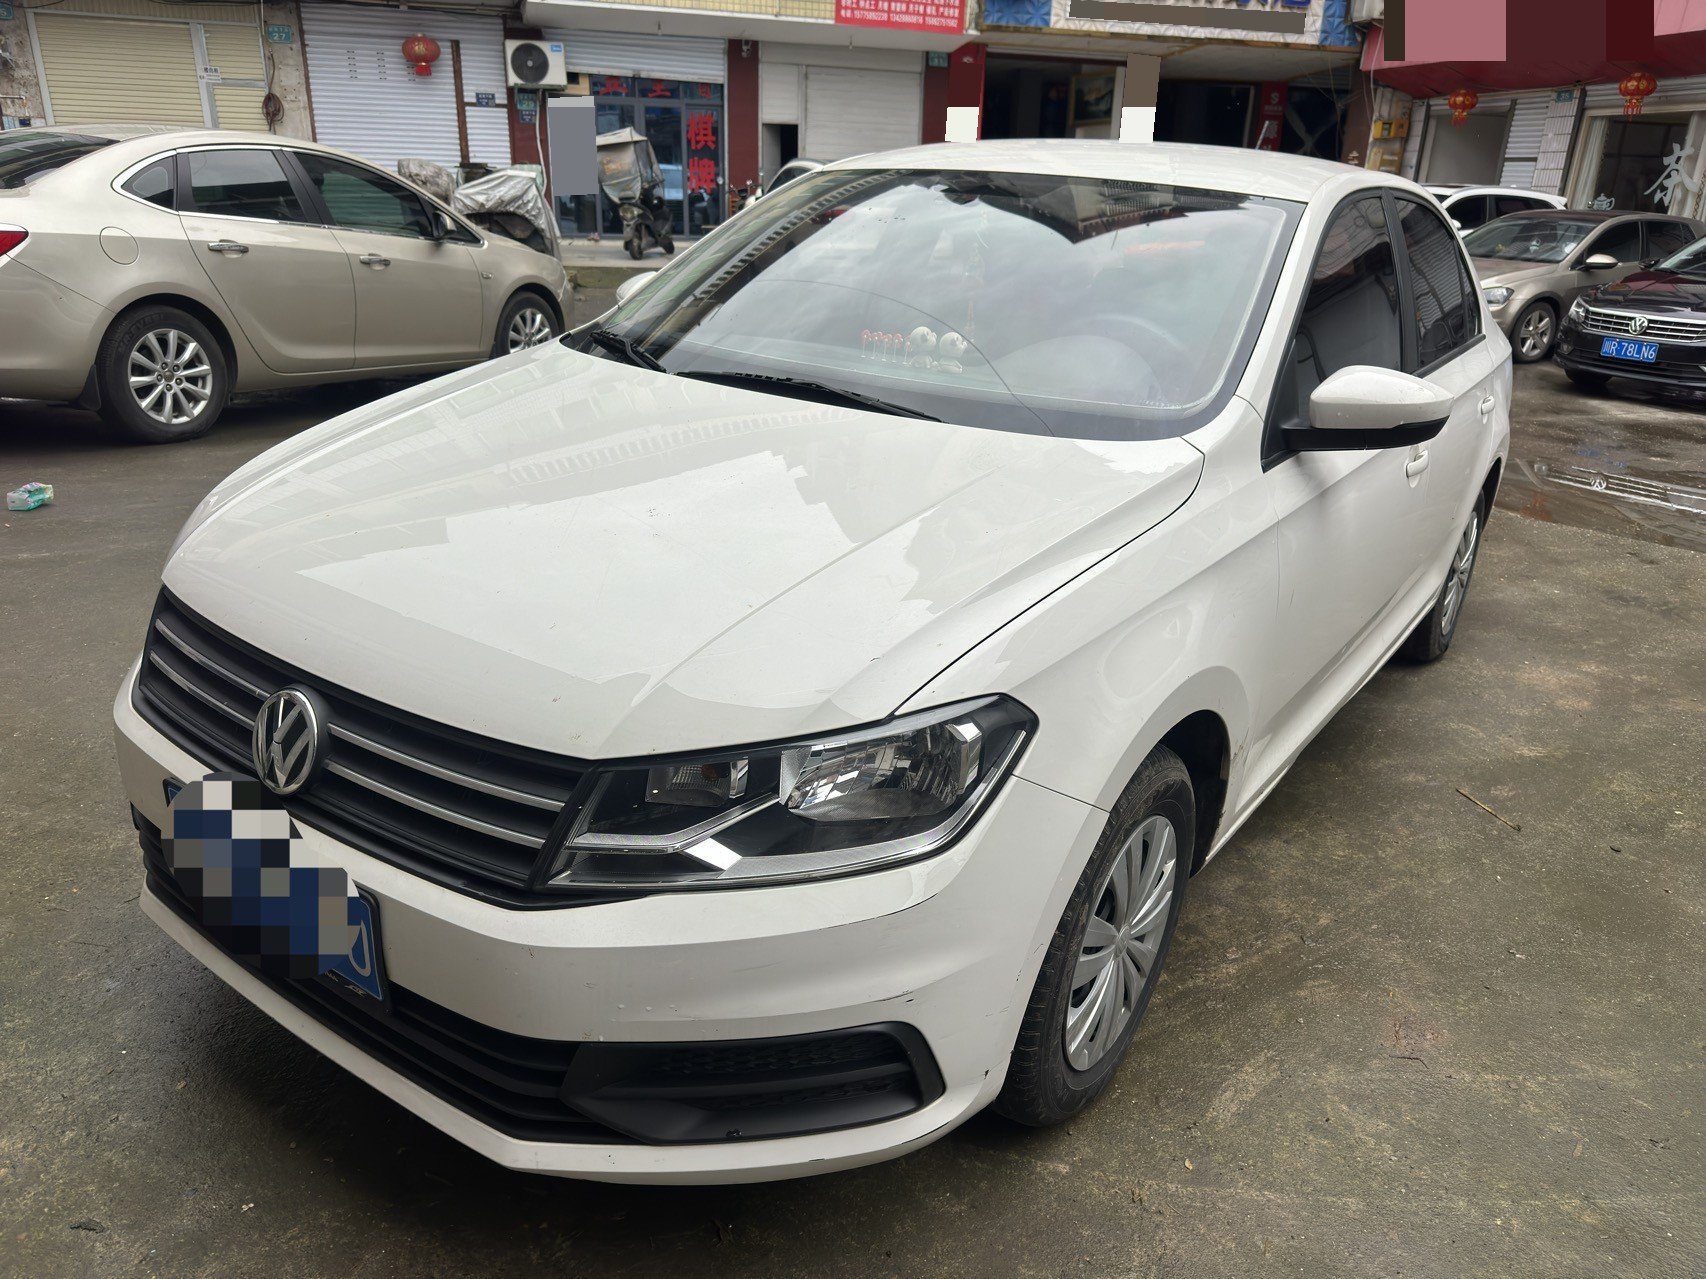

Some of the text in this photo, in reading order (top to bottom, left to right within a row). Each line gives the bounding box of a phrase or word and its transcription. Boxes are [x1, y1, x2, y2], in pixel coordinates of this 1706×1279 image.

[272, 32, 286, 41] 27
[685, 110, 717, 195] 棋牌
[1643, 142, 1699, 207] 茶
